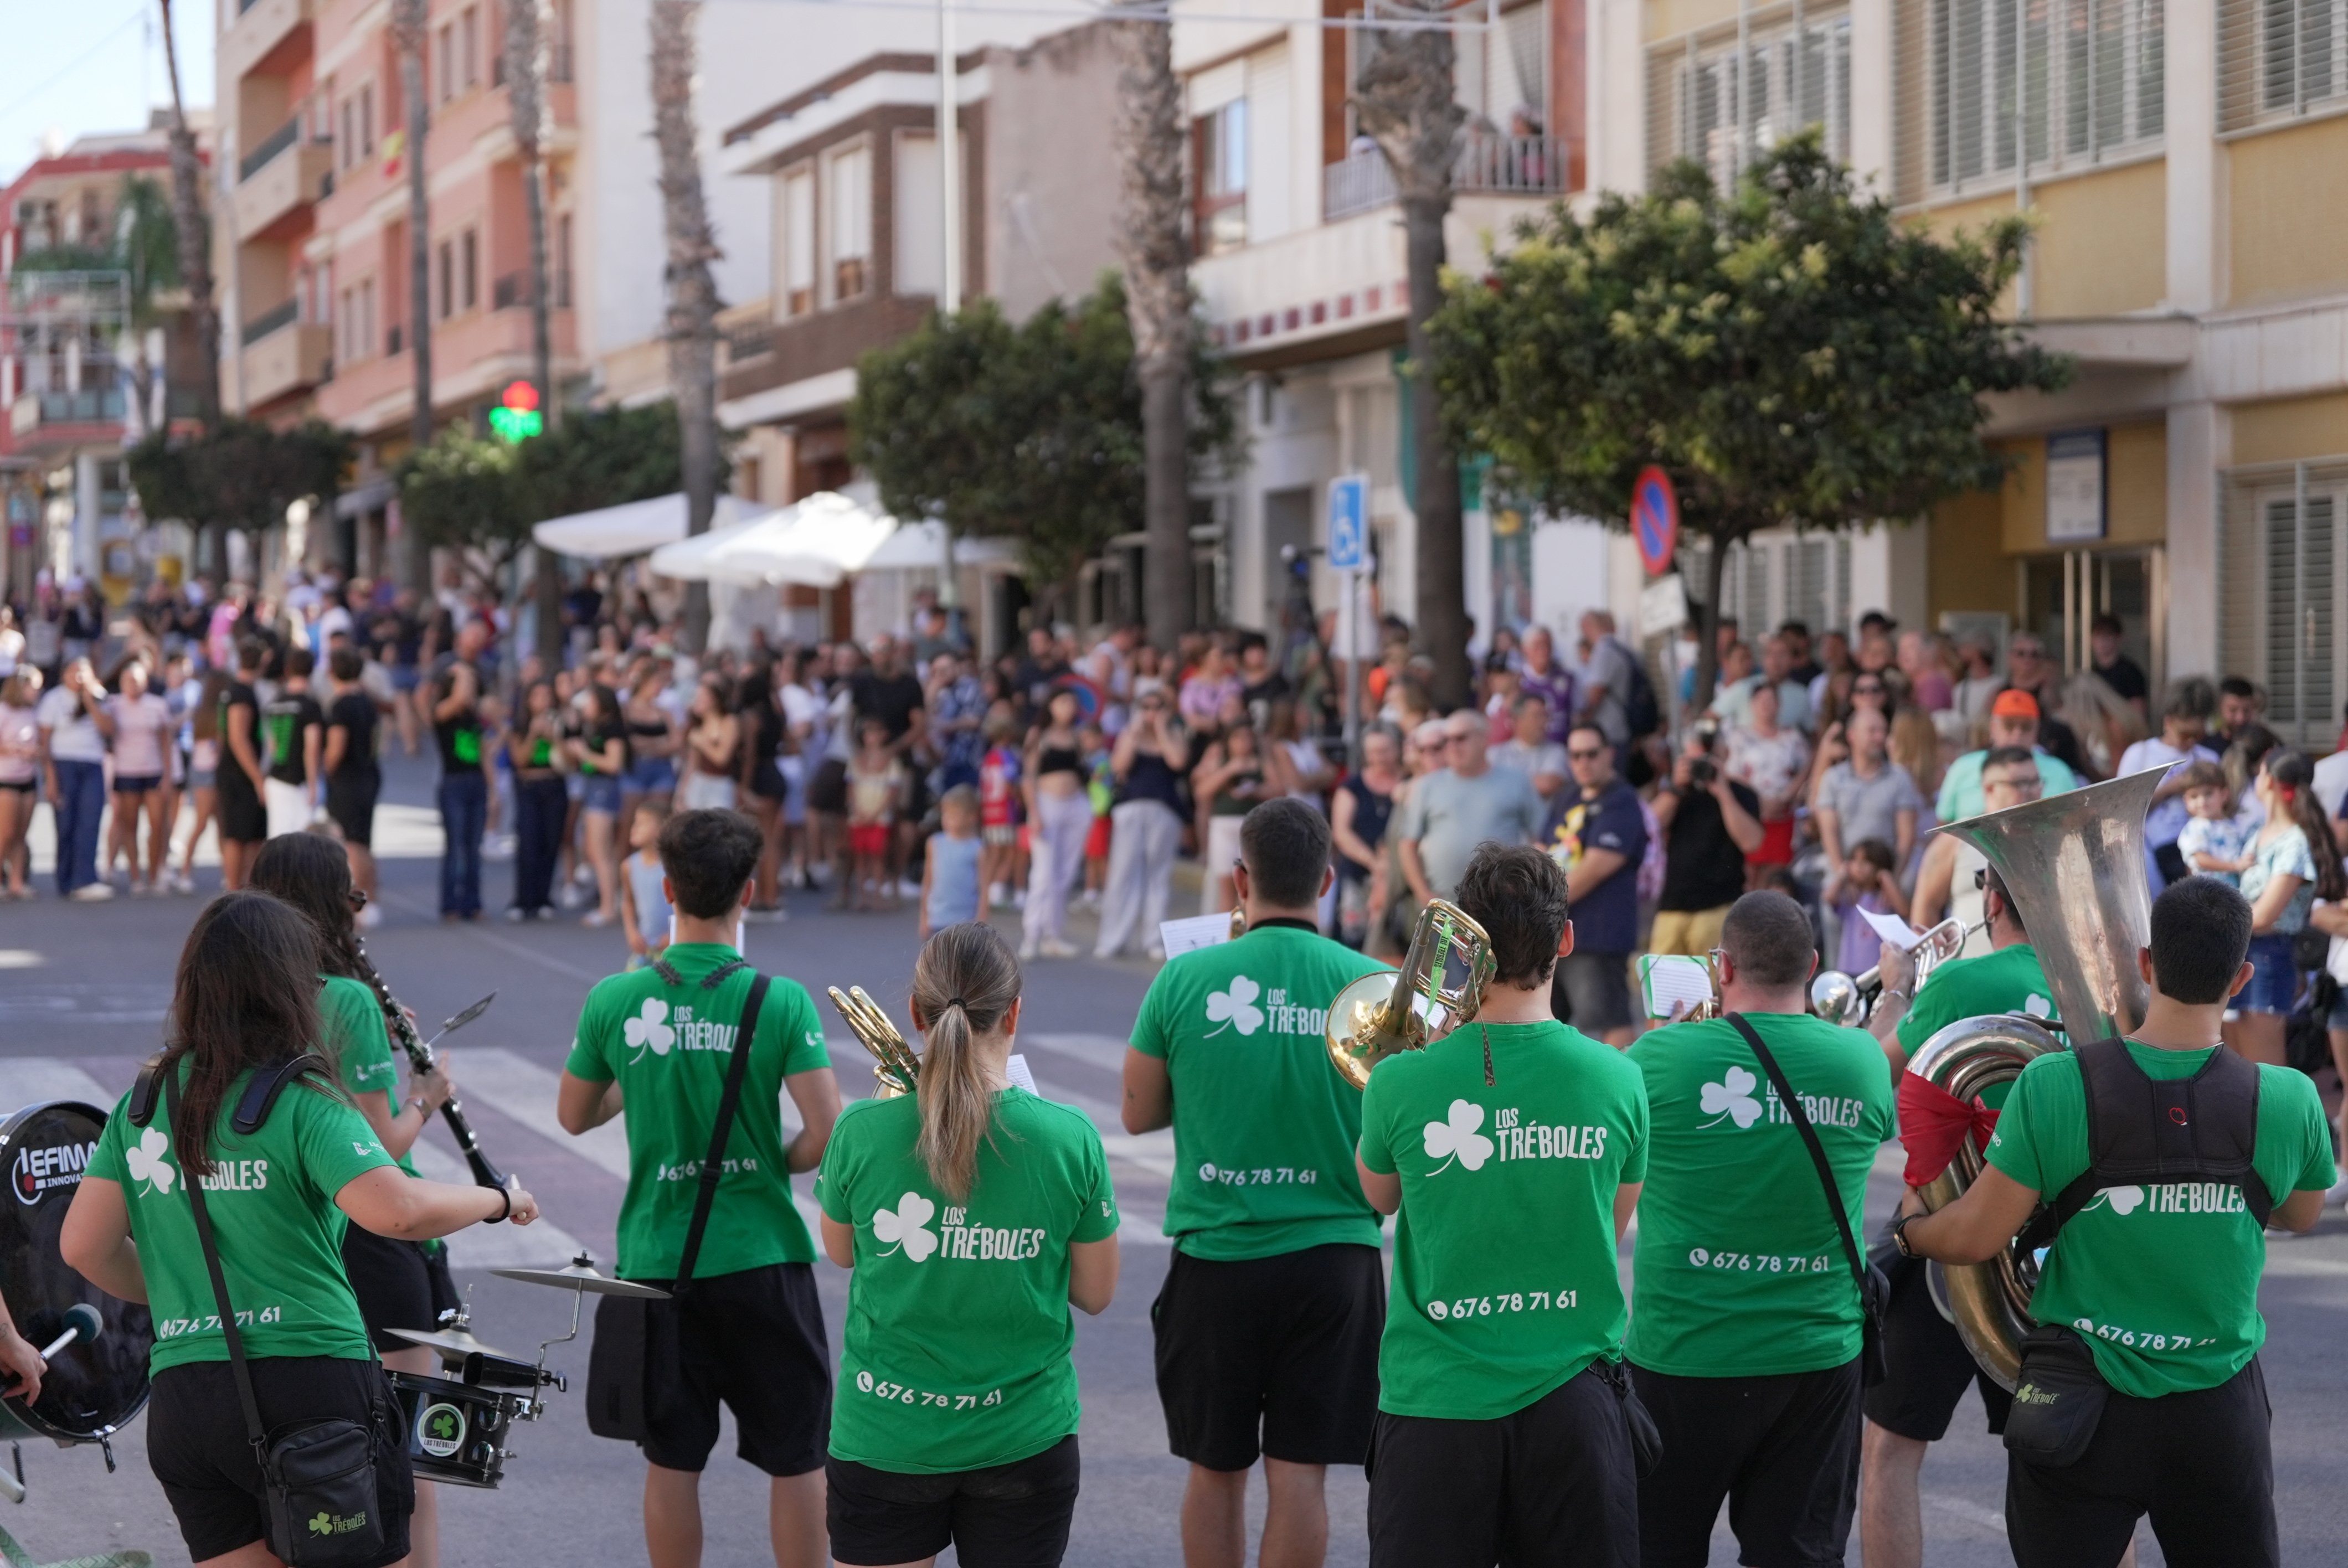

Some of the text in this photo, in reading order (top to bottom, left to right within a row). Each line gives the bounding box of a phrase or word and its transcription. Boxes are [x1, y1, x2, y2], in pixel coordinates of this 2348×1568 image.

[1267, 988, 1286, 1005] LOS
[673, 1006, 693, 1022] LOS
[1266, 1002, 1328, 1036] TRÉBOL
[673, 1018, 754, 1053] TRÉBOL
[1495, 1108, 1518, 1129] LOS
[1495, 1120, 1607, 1162] TRÉBOLES
[47, 1172, 83, 1187] INNOVA
[667, 1160, 697, 1181] 676
[721, 1159, 739, 1173] 71
[742, 1158, 758, 1171] 61
[1250, 1168, 1271, 1184] 78
[1276, 1168, 1294, 1183] 71
[1298, 1169, 1317, 1184] 61
[943, 1206, 966, 1225] LOS
[940, 1222, 1045, 1261] TRÉBOLES
[1713, 1252, 1829, 1272] 676 78 71 61
[1452, 1290, 1577, 1319] 676 78 71 61
[168, 1318, 200, 1336] 676
[235, 1310, 253, 1327] 71
[260, 1306, 280, 1323] 61
[2097, 1324, 2135, 1345] 676
[2139, 1333, 2166, 1350] 78
[2169, 1335, 2191, 1350] 71
[876, 1381, 1001, 1410] 676 78 71 61
[434, 1440, 456, 1449] TRÉBOLES
[333, 1513, 365, 1533] TRÉBOLES
